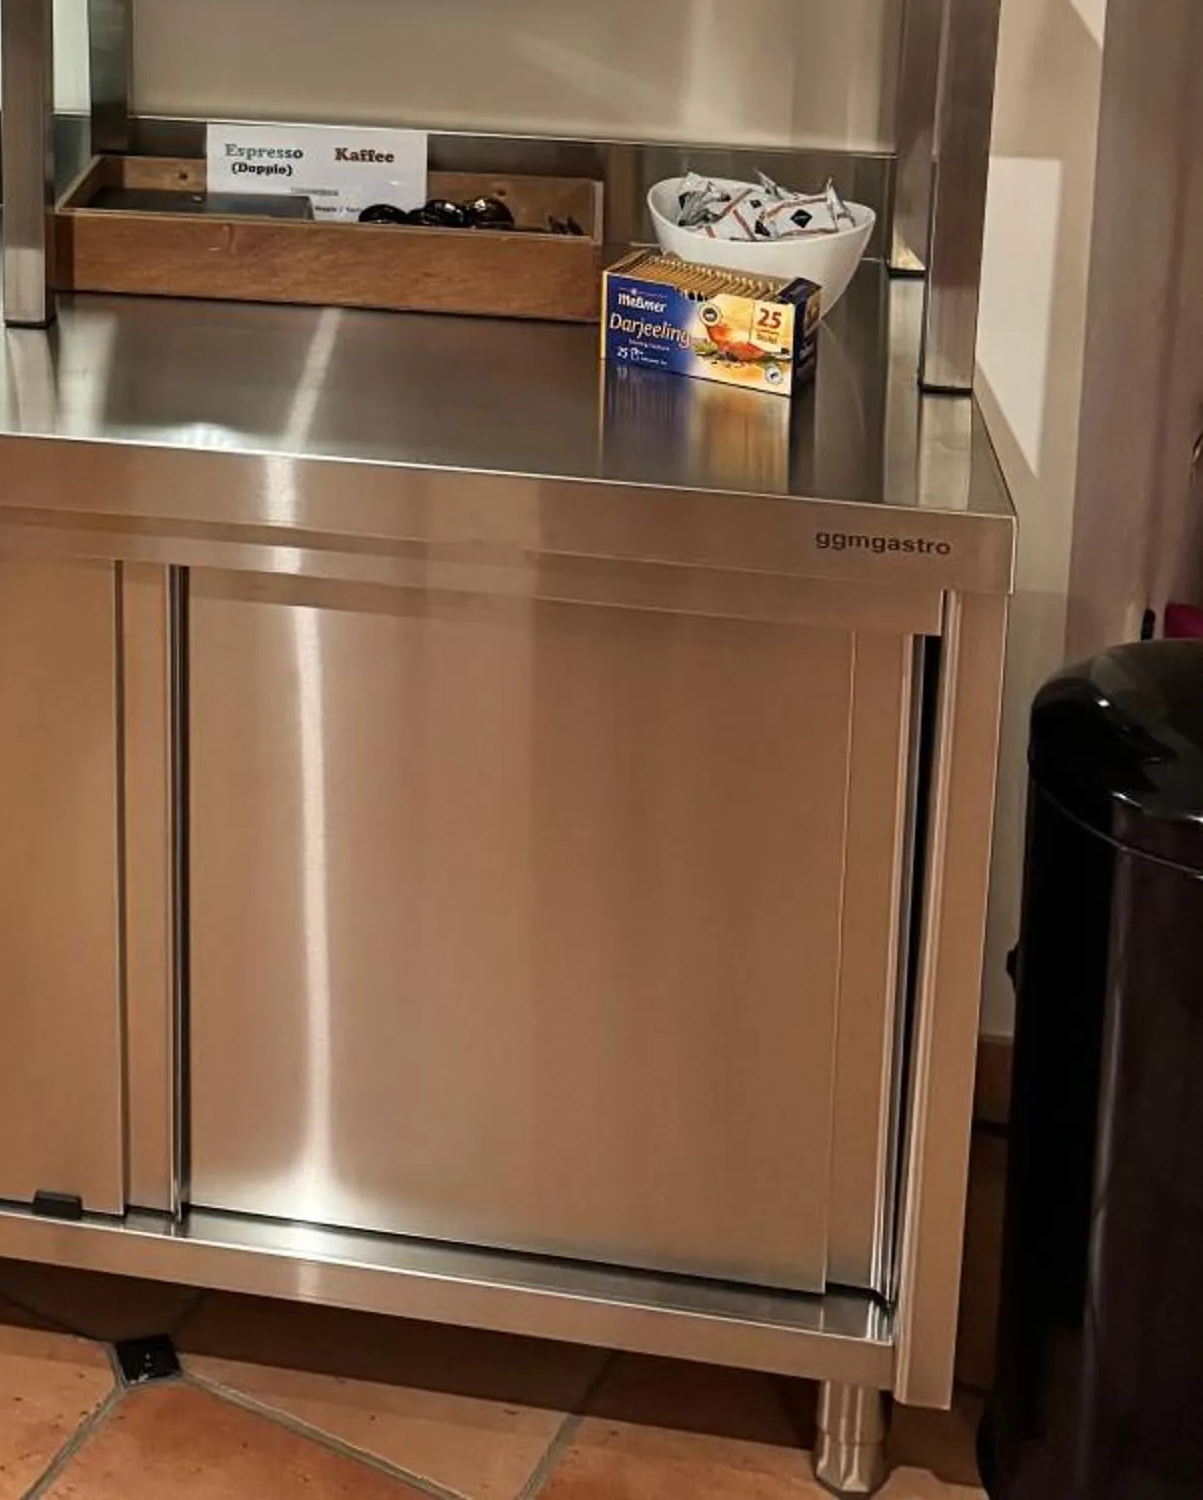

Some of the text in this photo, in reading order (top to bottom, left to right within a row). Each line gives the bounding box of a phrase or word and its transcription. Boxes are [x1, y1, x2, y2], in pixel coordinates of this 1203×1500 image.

[224, 143, 395, 164] Espresso Kaffee
[231, 161, 294, 177] (Doppio)
[757, 308, 782, 329] 25
[609, 312, 690, 349] Darjeeling
[815, 531, 951, 556] ggmgastro
